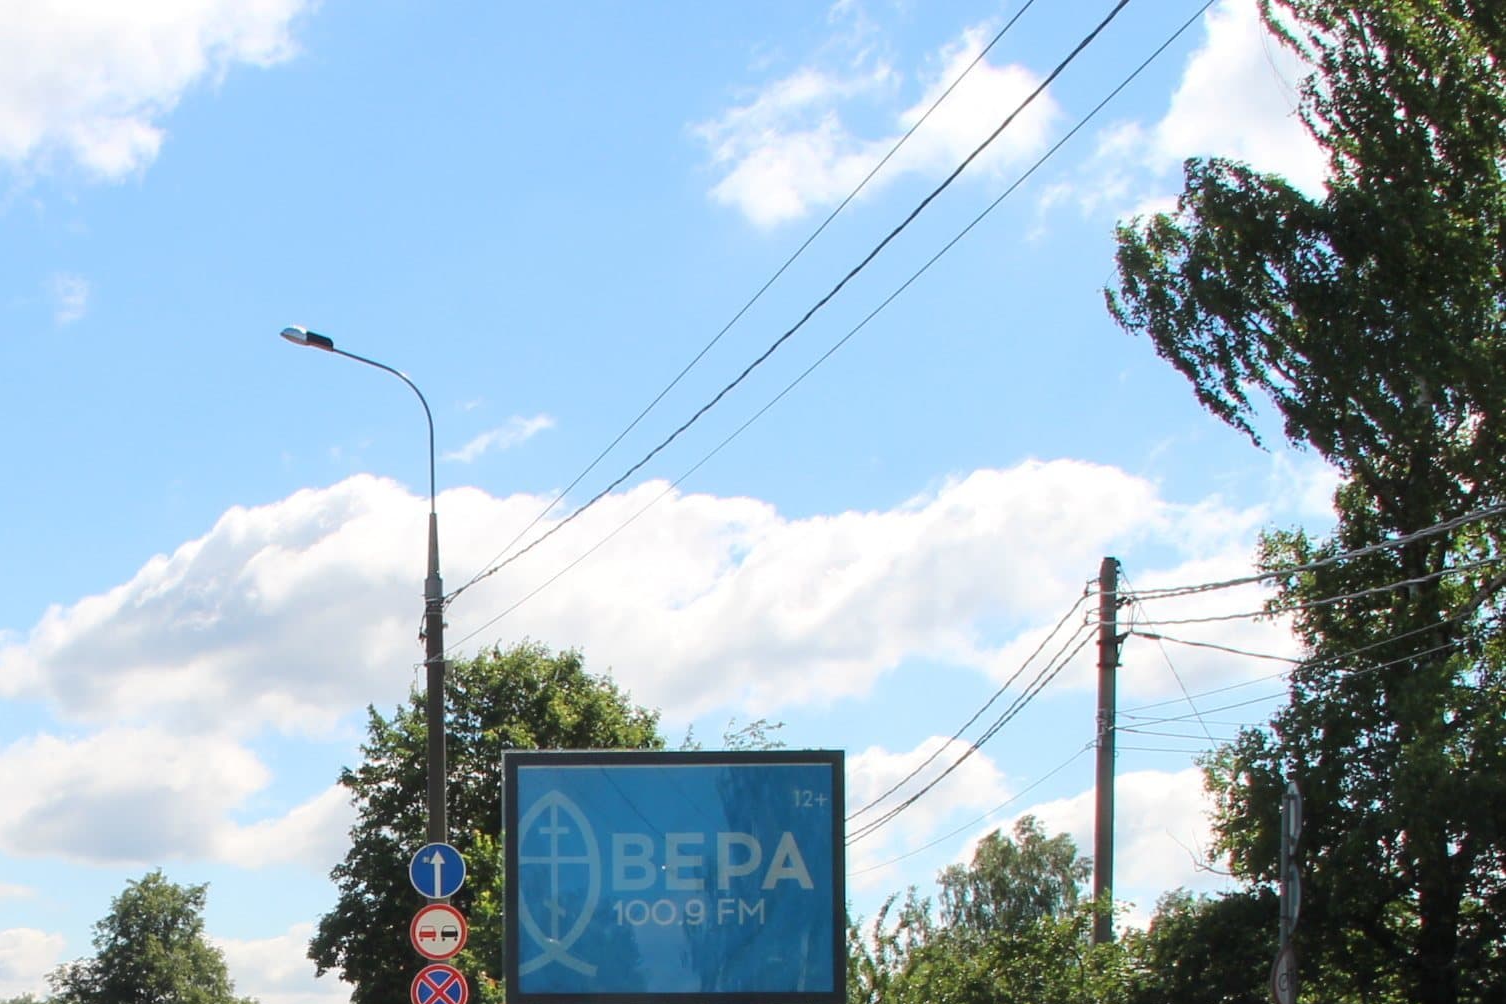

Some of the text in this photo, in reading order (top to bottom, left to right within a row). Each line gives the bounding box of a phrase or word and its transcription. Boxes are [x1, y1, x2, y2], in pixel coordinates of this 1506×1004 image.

[794, 789, 829, 808] 12+
[611, 831, 815, 891] ВЕРА
[612, 898, 766, 926] 100.9 FM
